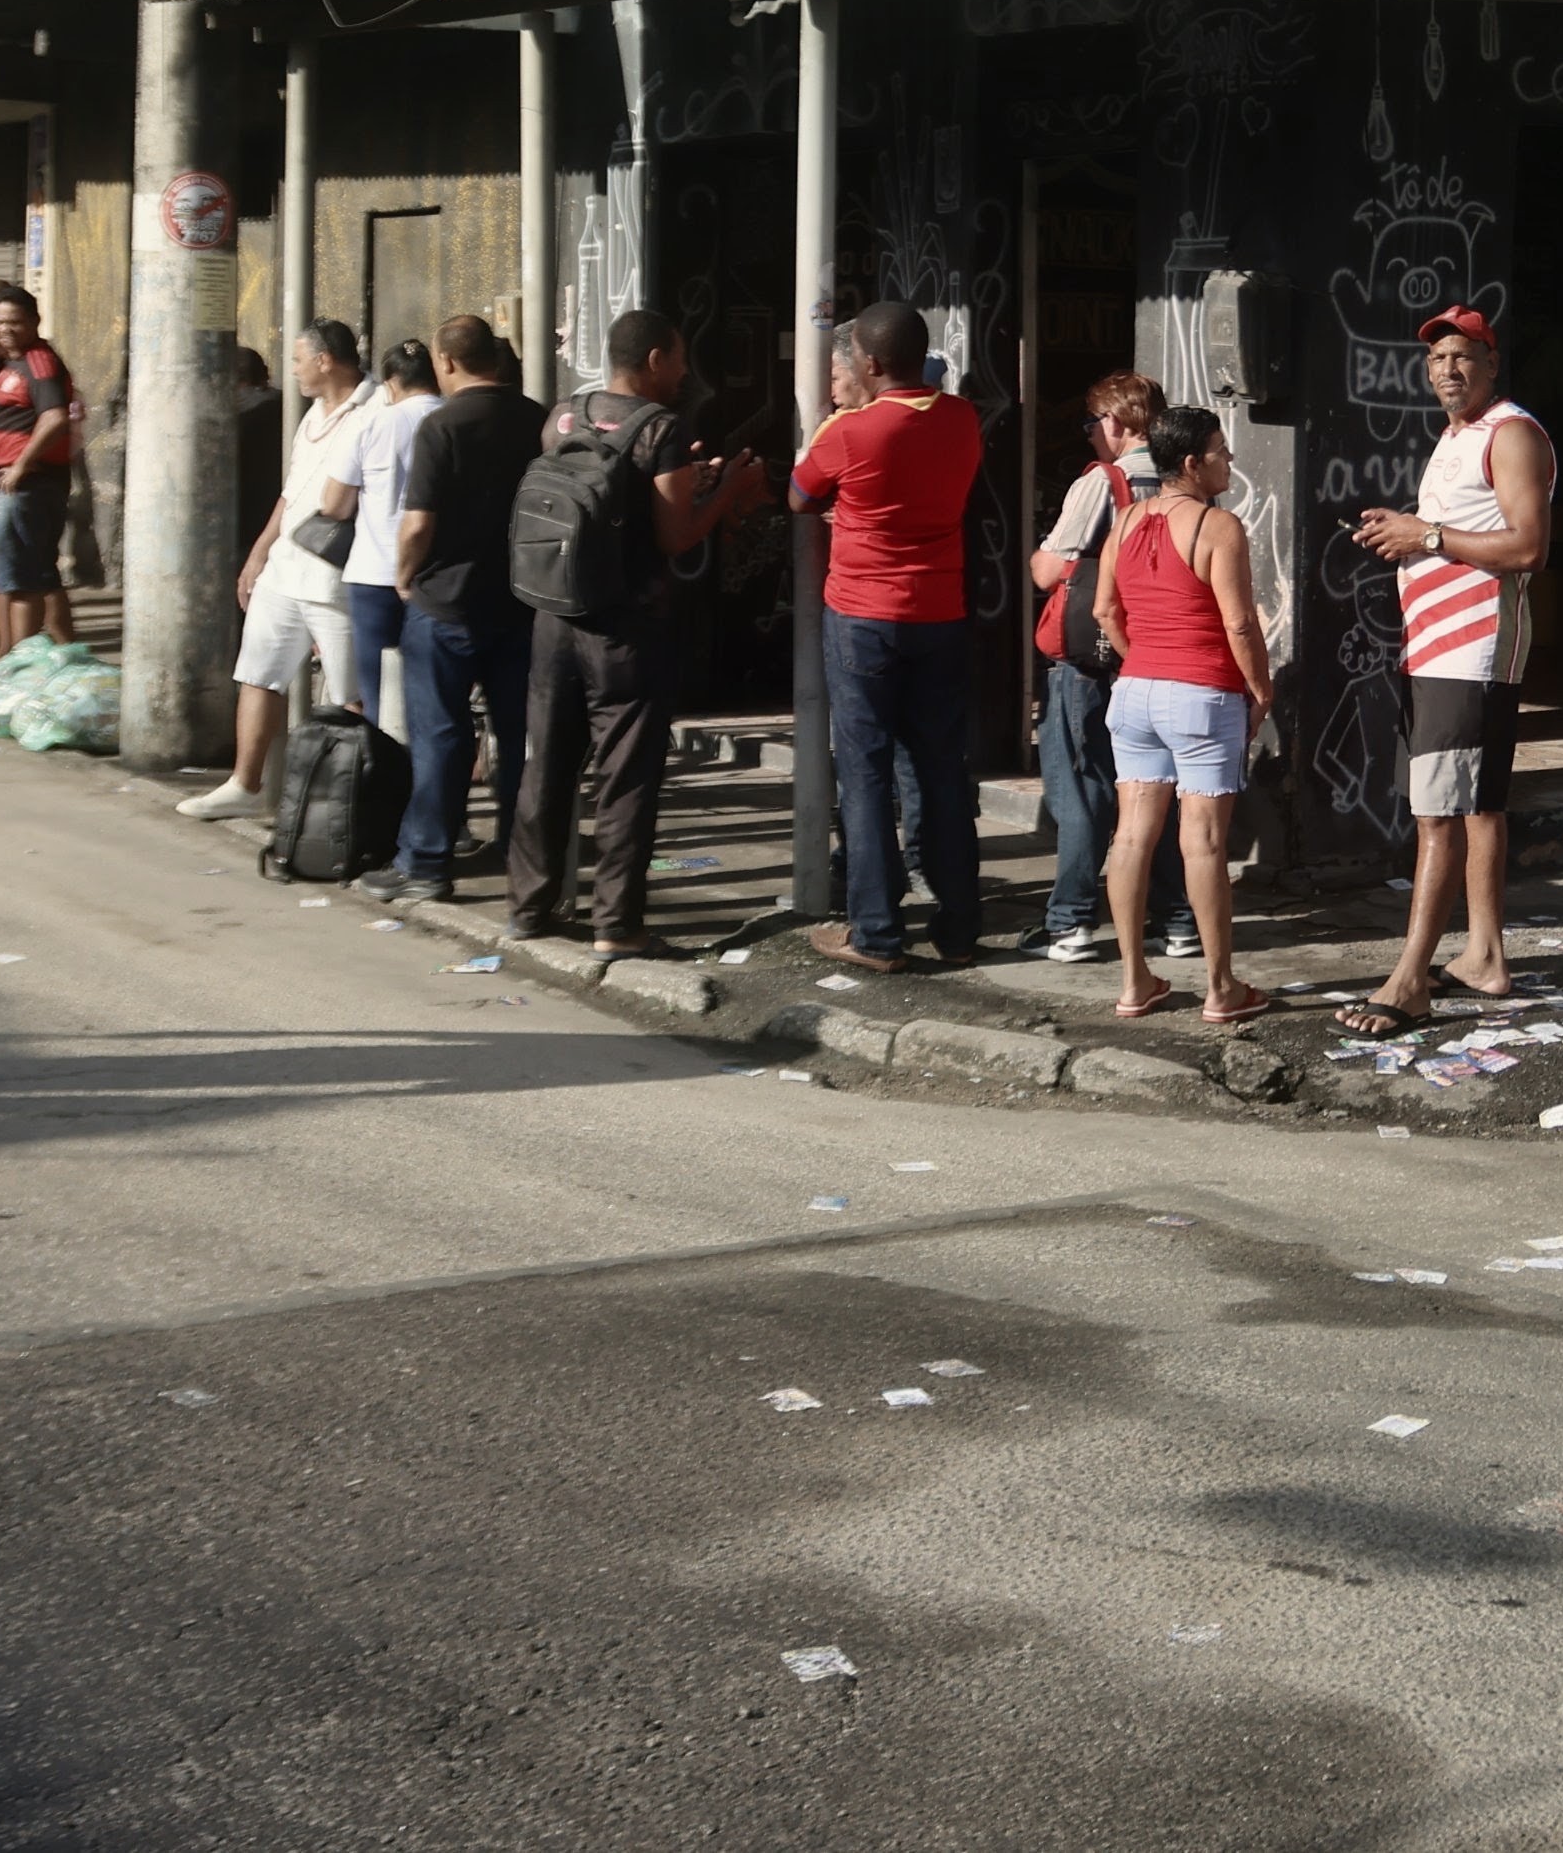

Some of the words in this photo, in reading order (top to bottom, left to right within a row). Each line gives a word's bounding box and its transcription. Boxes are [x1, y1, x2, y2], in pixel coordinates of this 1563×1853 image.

[1380, 160, 1424, 210] tô
[1426, 155, 1464, 211] de
[1039, 213, 1134, 263] NACK
[1040, 298, 1121, 346] OINT
[1354, 348, 1431, 397] BAC
